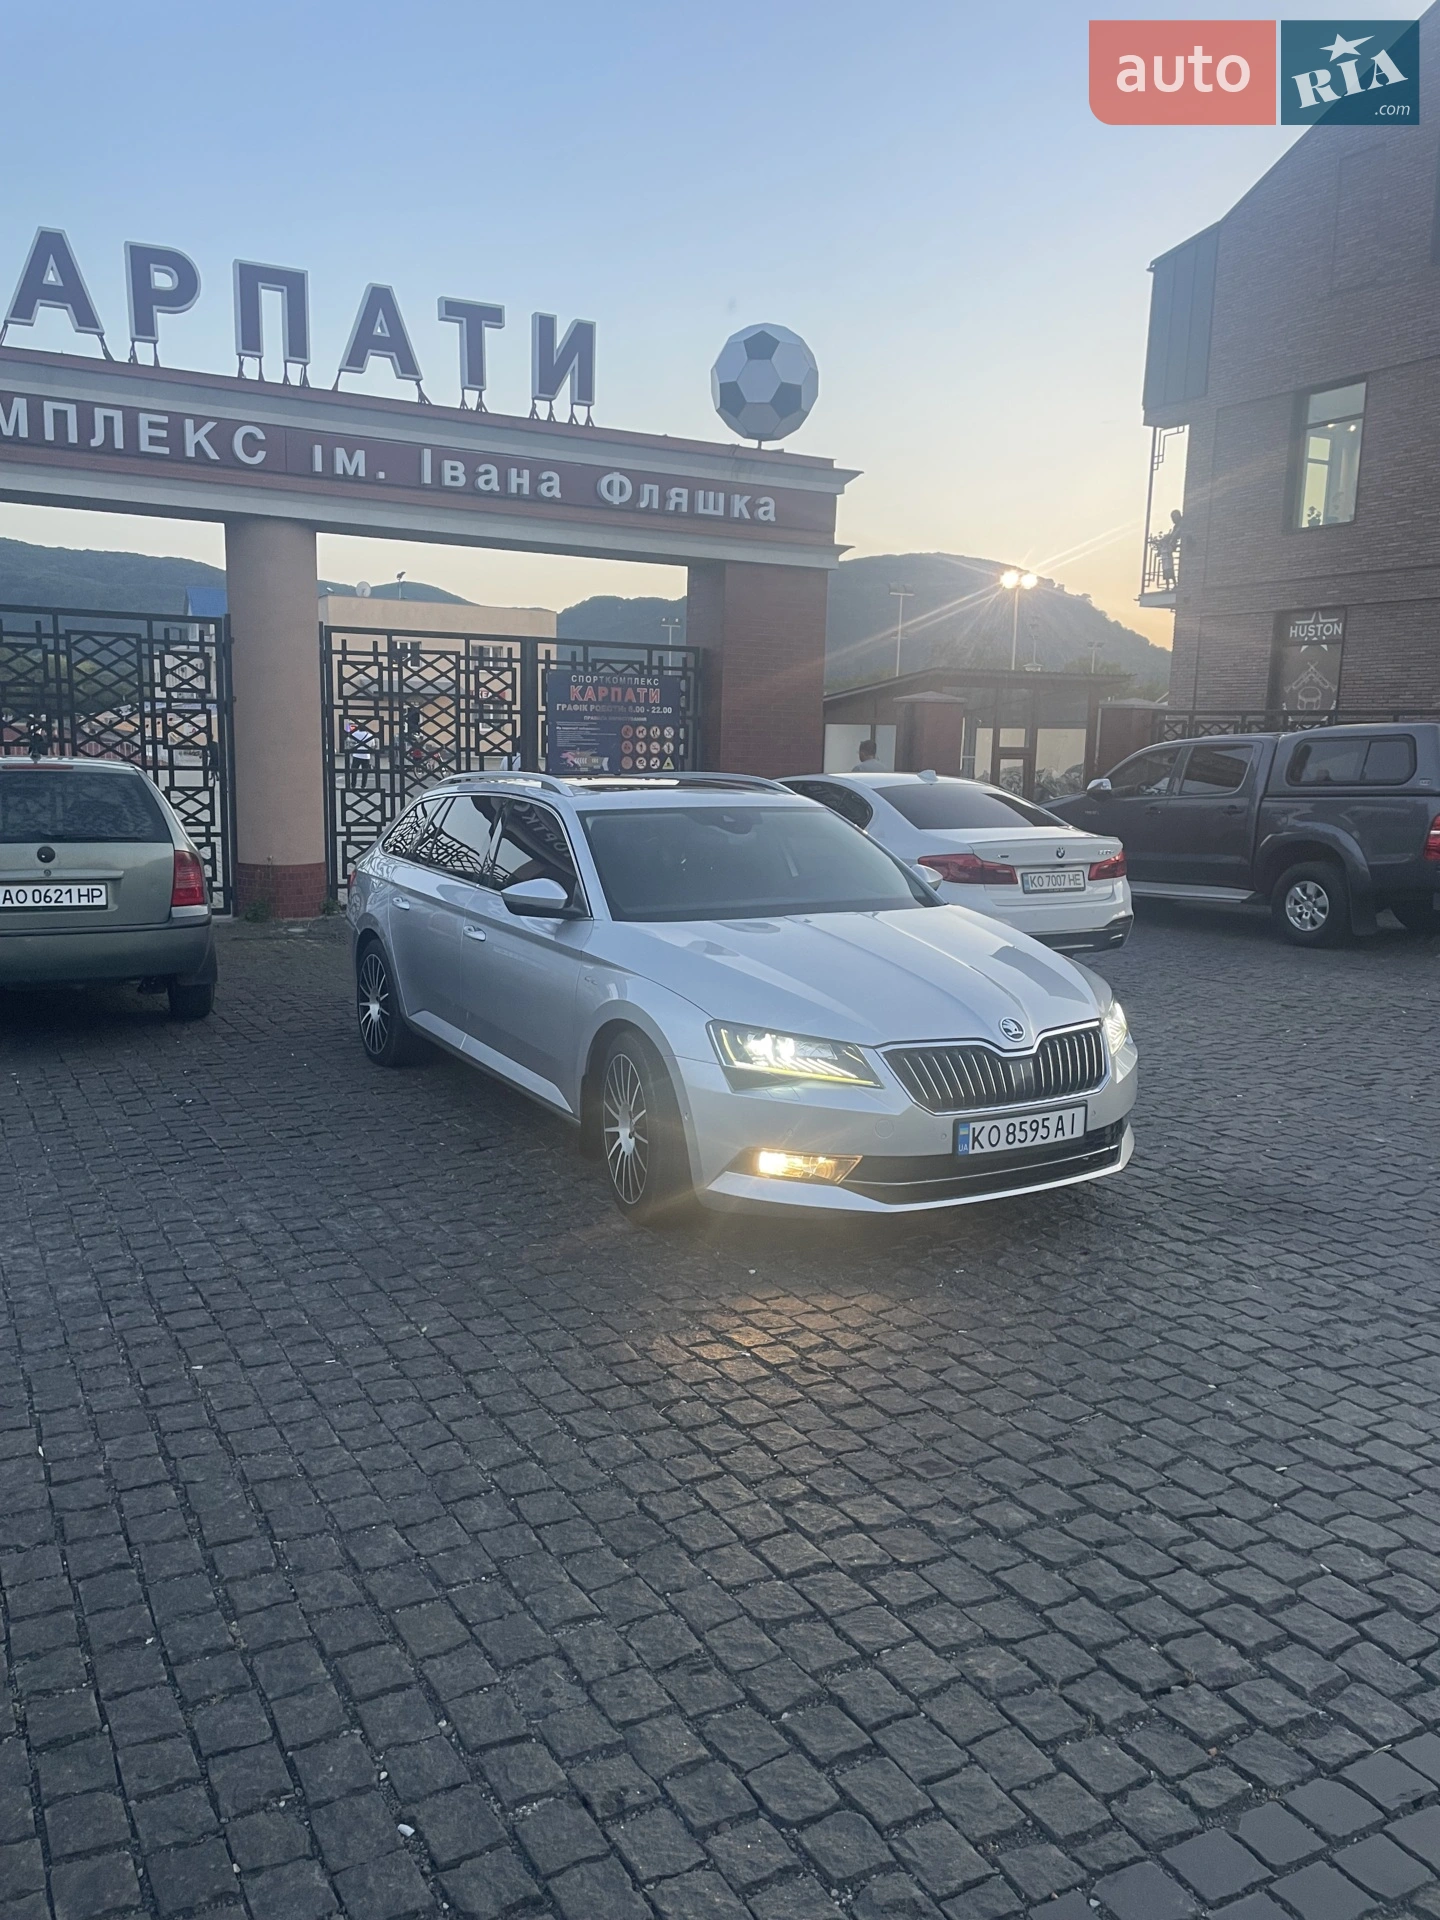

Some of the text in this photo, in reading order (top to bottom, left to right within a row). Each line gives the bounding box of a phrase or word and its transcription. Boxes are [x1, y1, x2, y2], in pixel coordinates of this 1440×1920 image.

[4, 226, 597, 406] АРПАТИ
[421, 448, 562, 499] Івана
[598, 471, 777, 522] Фляшка
[1289, 623, 1342, 638] HUSTON
[571, 675, 660, 686] СПОРТКОМПЛЕКС
[570, 685, 660, 704] КАРПАТИ
[556, 703, 588, 712] ГРАФІК
[651, 706, 672, 714] 22.00
[1046, 873, 1066, 887] 7007
[31, 888, 73, 904] 0621
[1005, 1117, 1050, 1145] 8595
